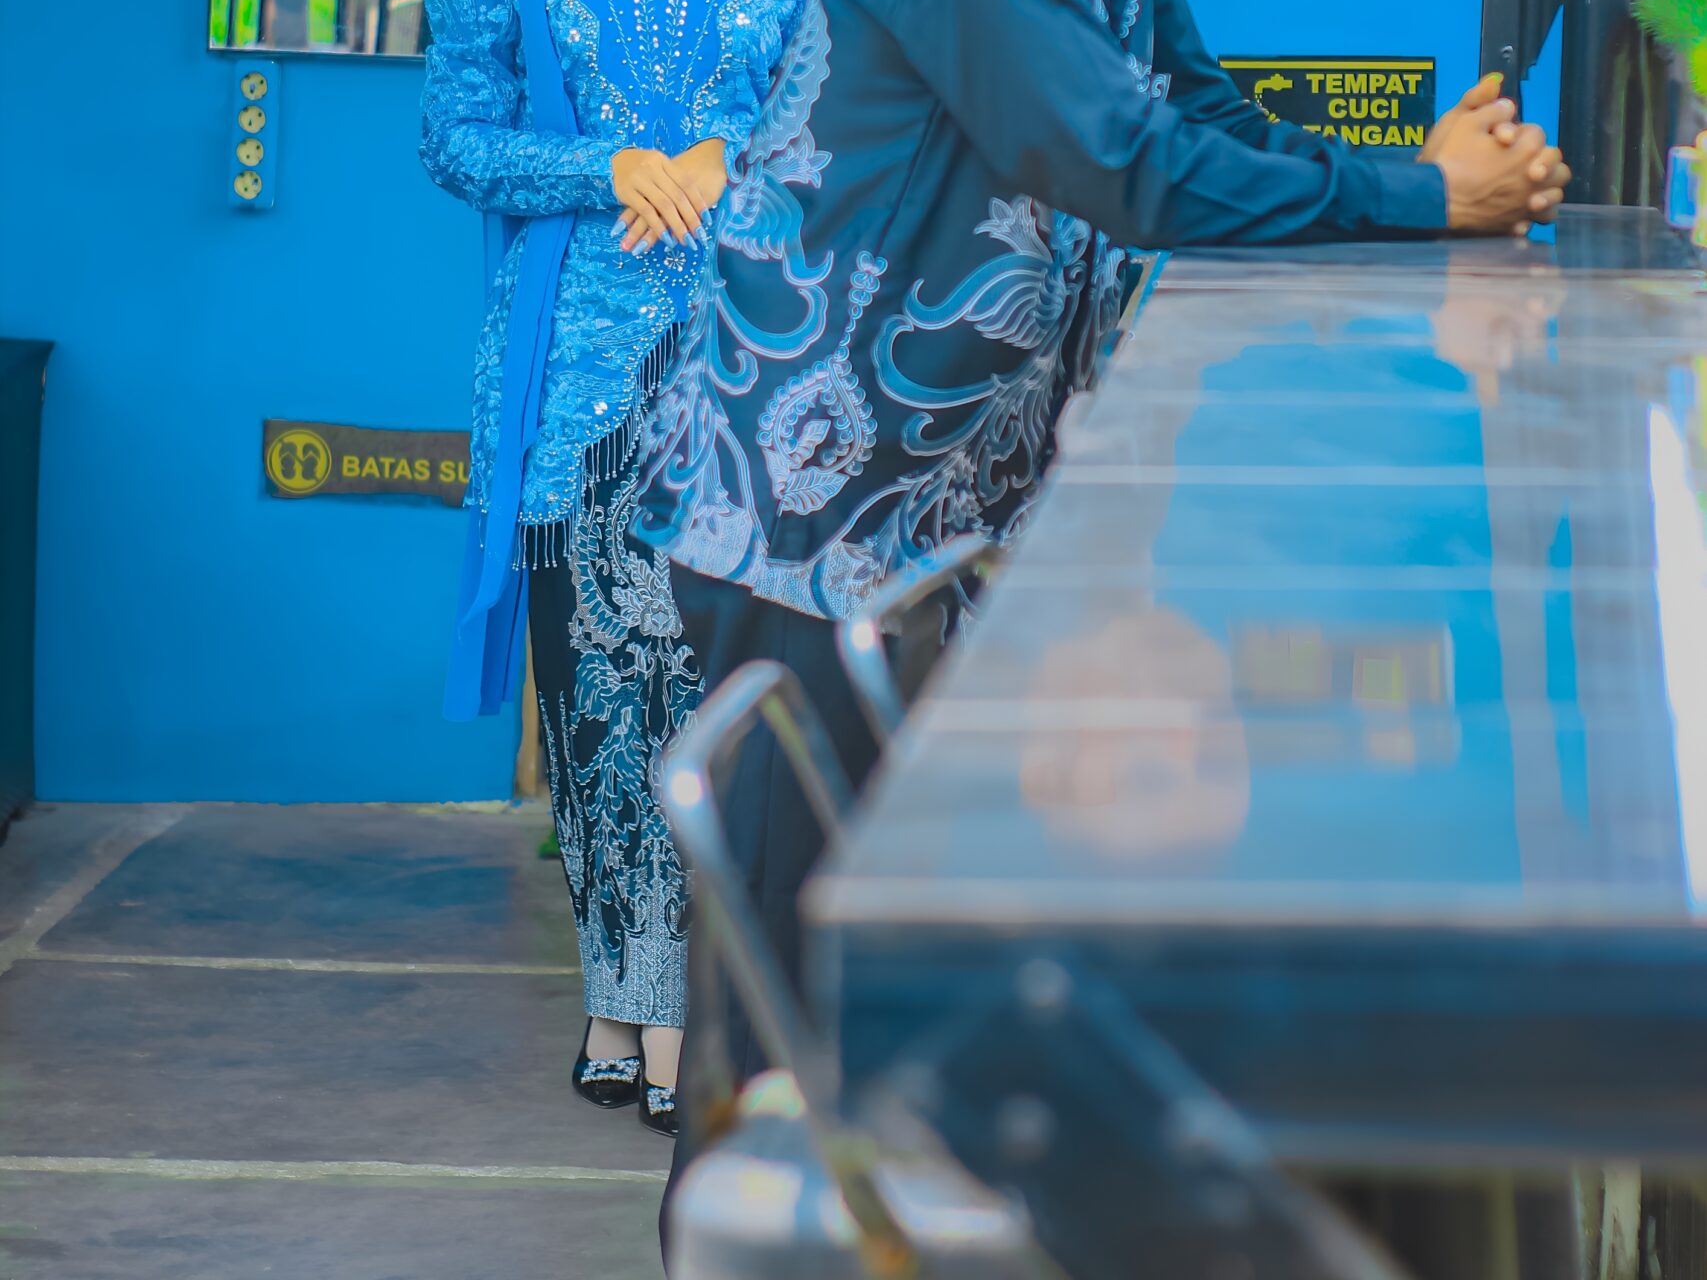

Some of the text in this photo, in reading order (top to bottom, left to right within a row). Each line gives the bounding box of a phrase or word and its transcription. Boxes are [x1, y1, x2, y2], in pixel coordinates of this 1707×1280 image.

[1306, 73, 1422, 94] TEMPAT
[1328, 98, 1399, 119] CUCI
[342, 455, 431, 481] BATAS
